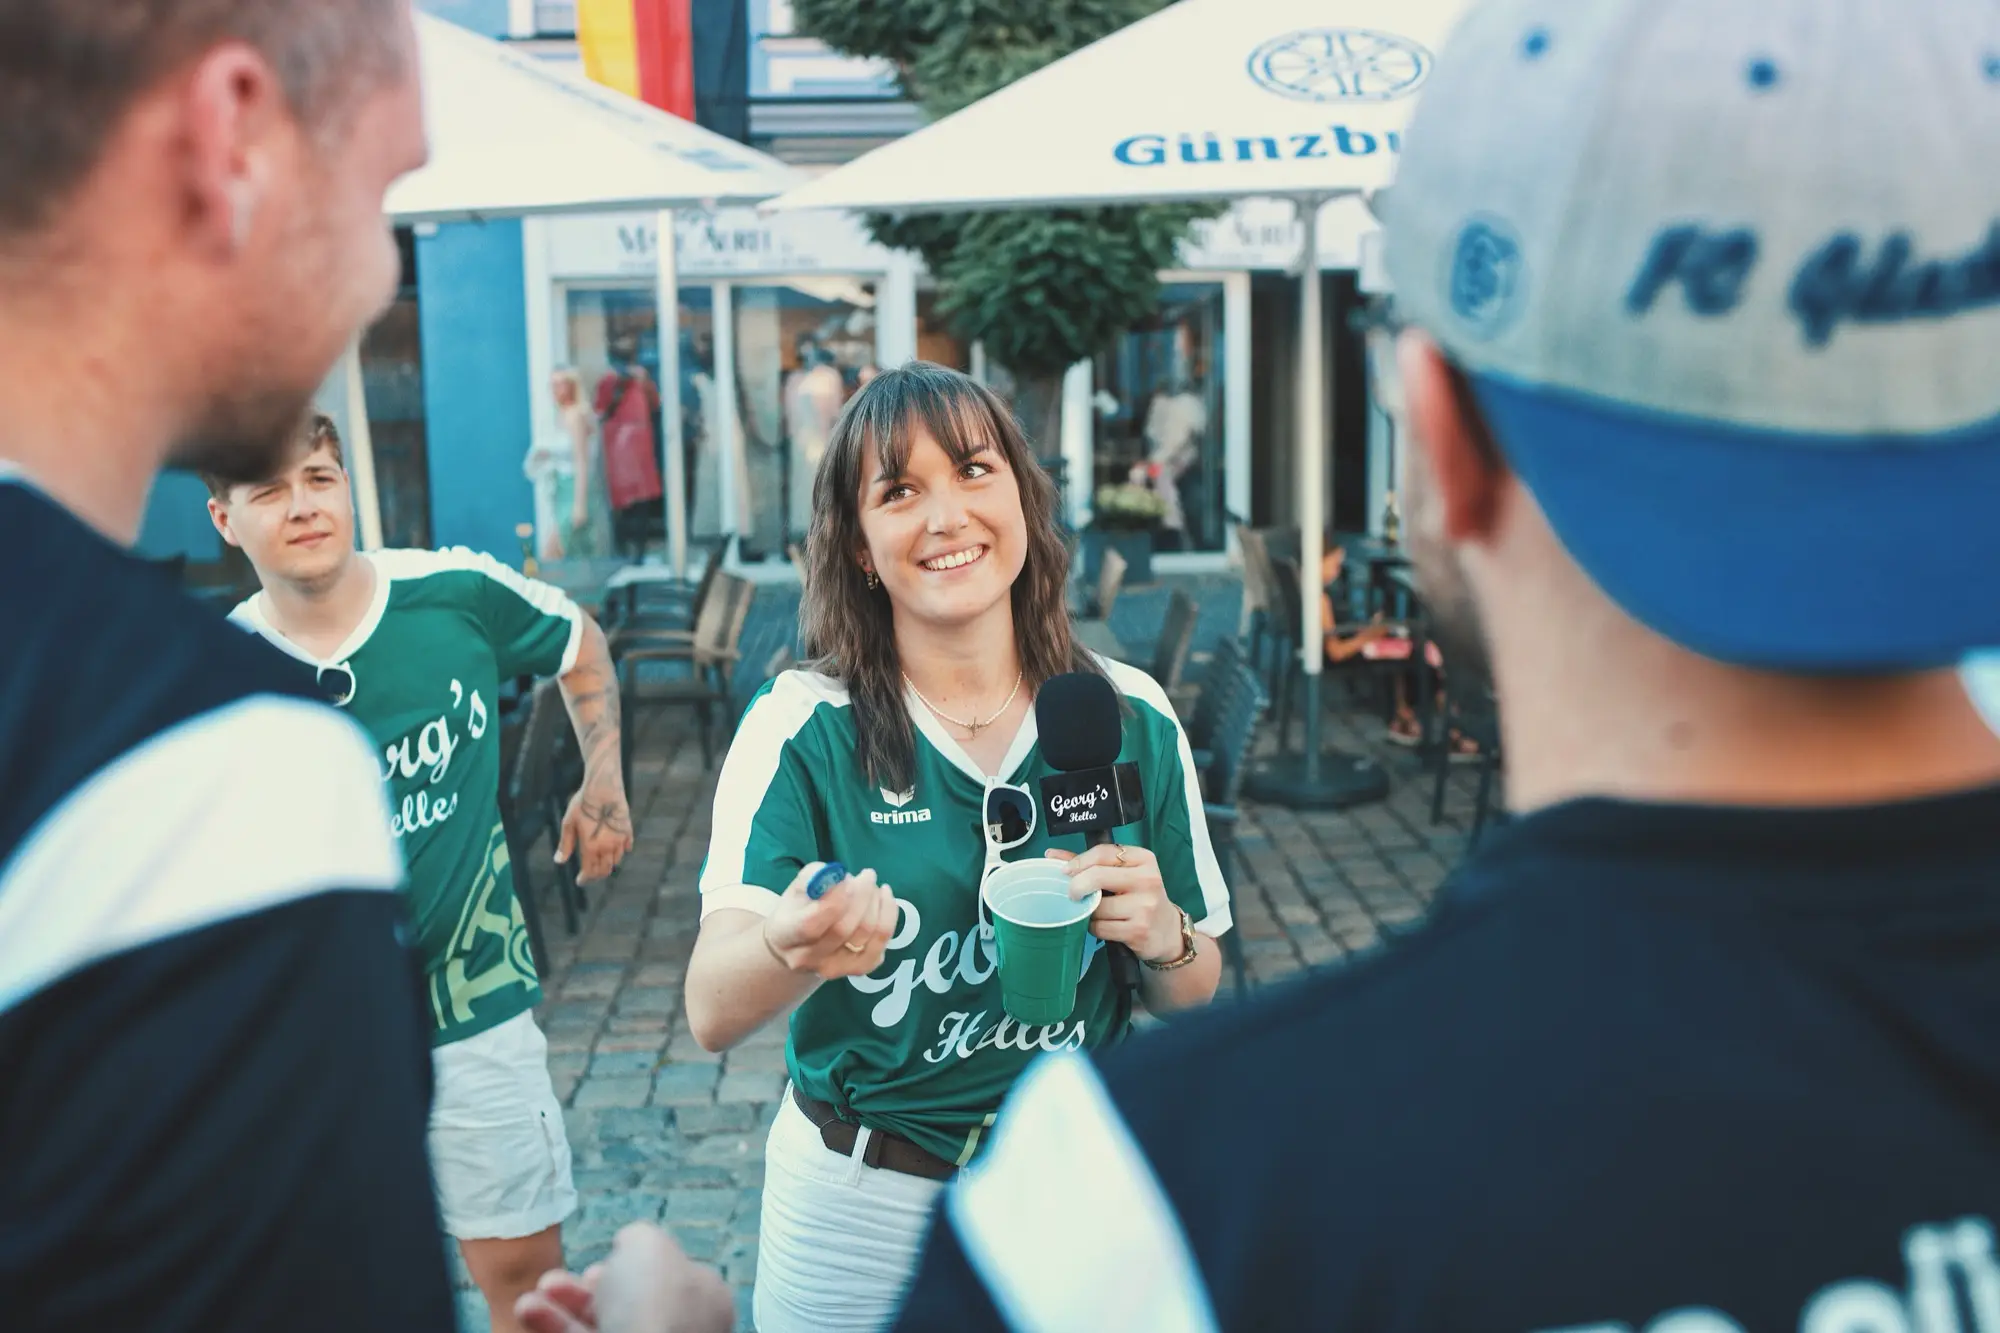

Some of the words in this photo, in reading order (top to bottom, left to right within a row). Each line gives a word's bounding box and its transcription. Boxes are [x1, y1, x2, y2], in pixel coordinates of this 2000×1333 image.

[383, 677, 488, 784] rg's
[390, 790, 459, 839] elles
[870, 808, 931, 824] erima
[1050, 784, 1108, 817] Georg's
[1069, 810, 1098, 822] Helles
